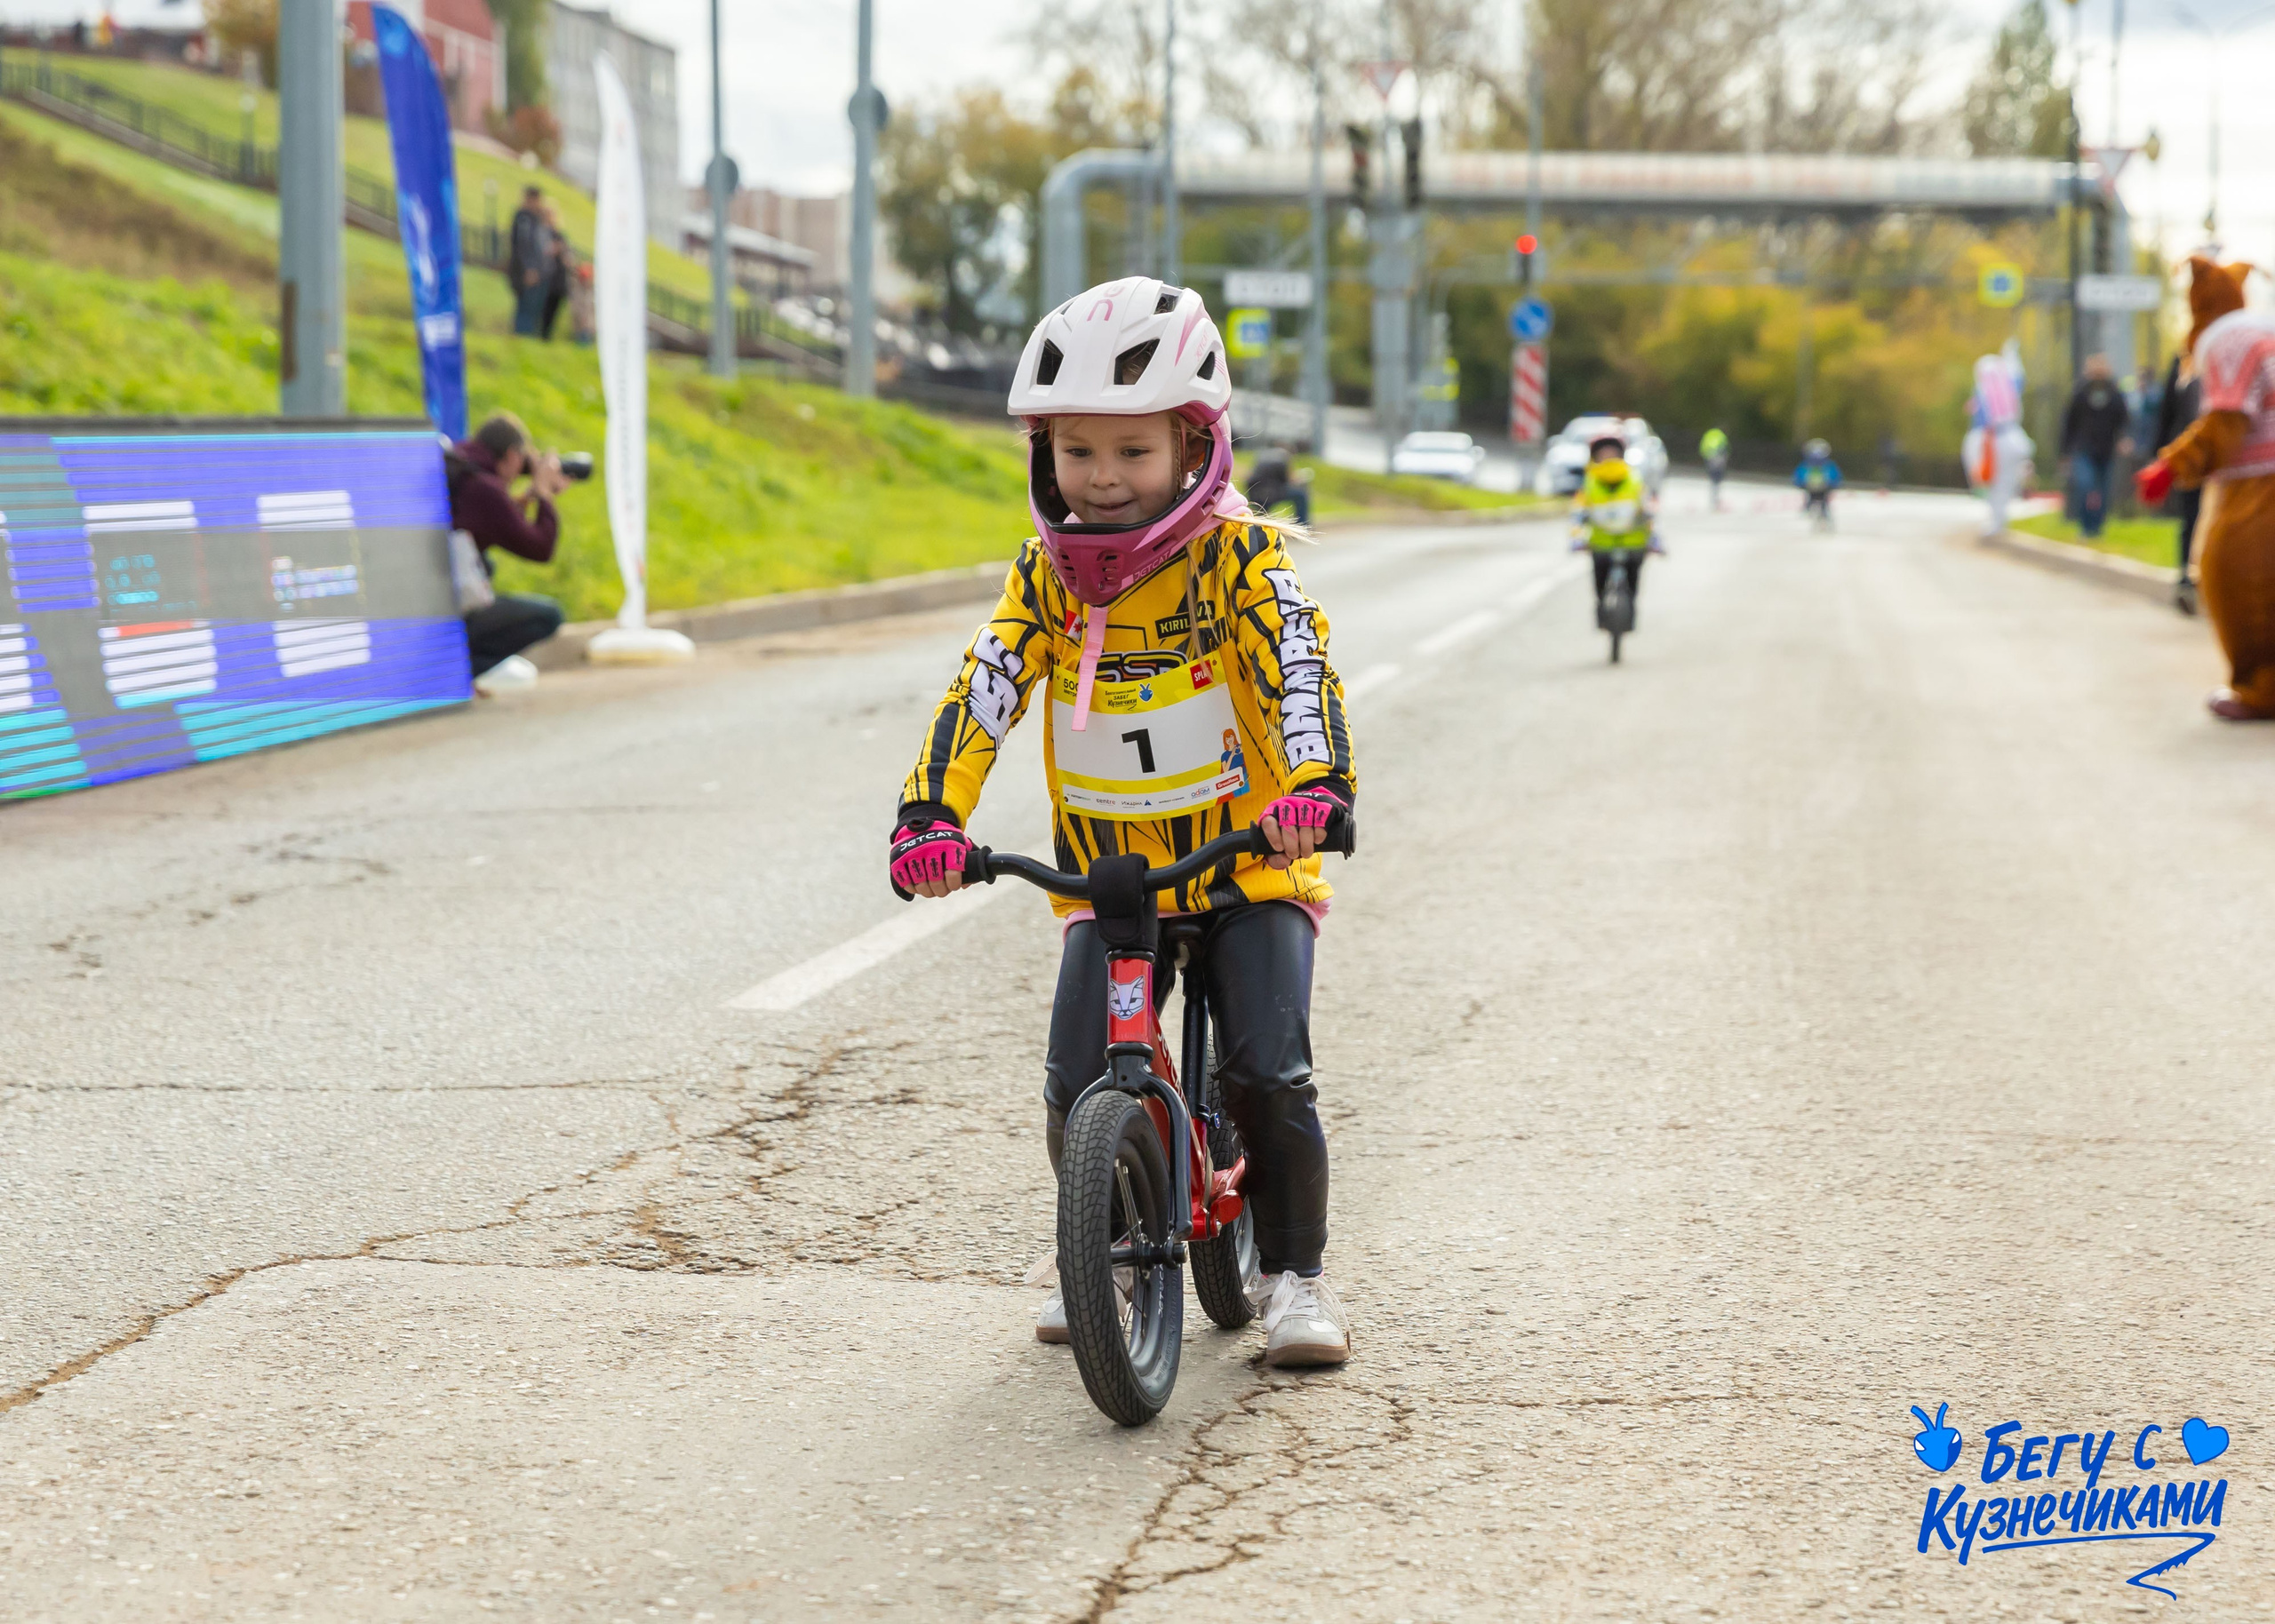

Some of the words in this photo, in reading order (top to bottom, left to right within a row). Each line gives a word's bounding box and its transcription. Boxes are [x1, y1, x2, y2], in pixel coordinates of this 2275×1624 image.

[1134, 551, 1171, 582] JETCAT
[1122, 728, 1156, 773] 1
[900, 832, 954, 852] JETCAT
